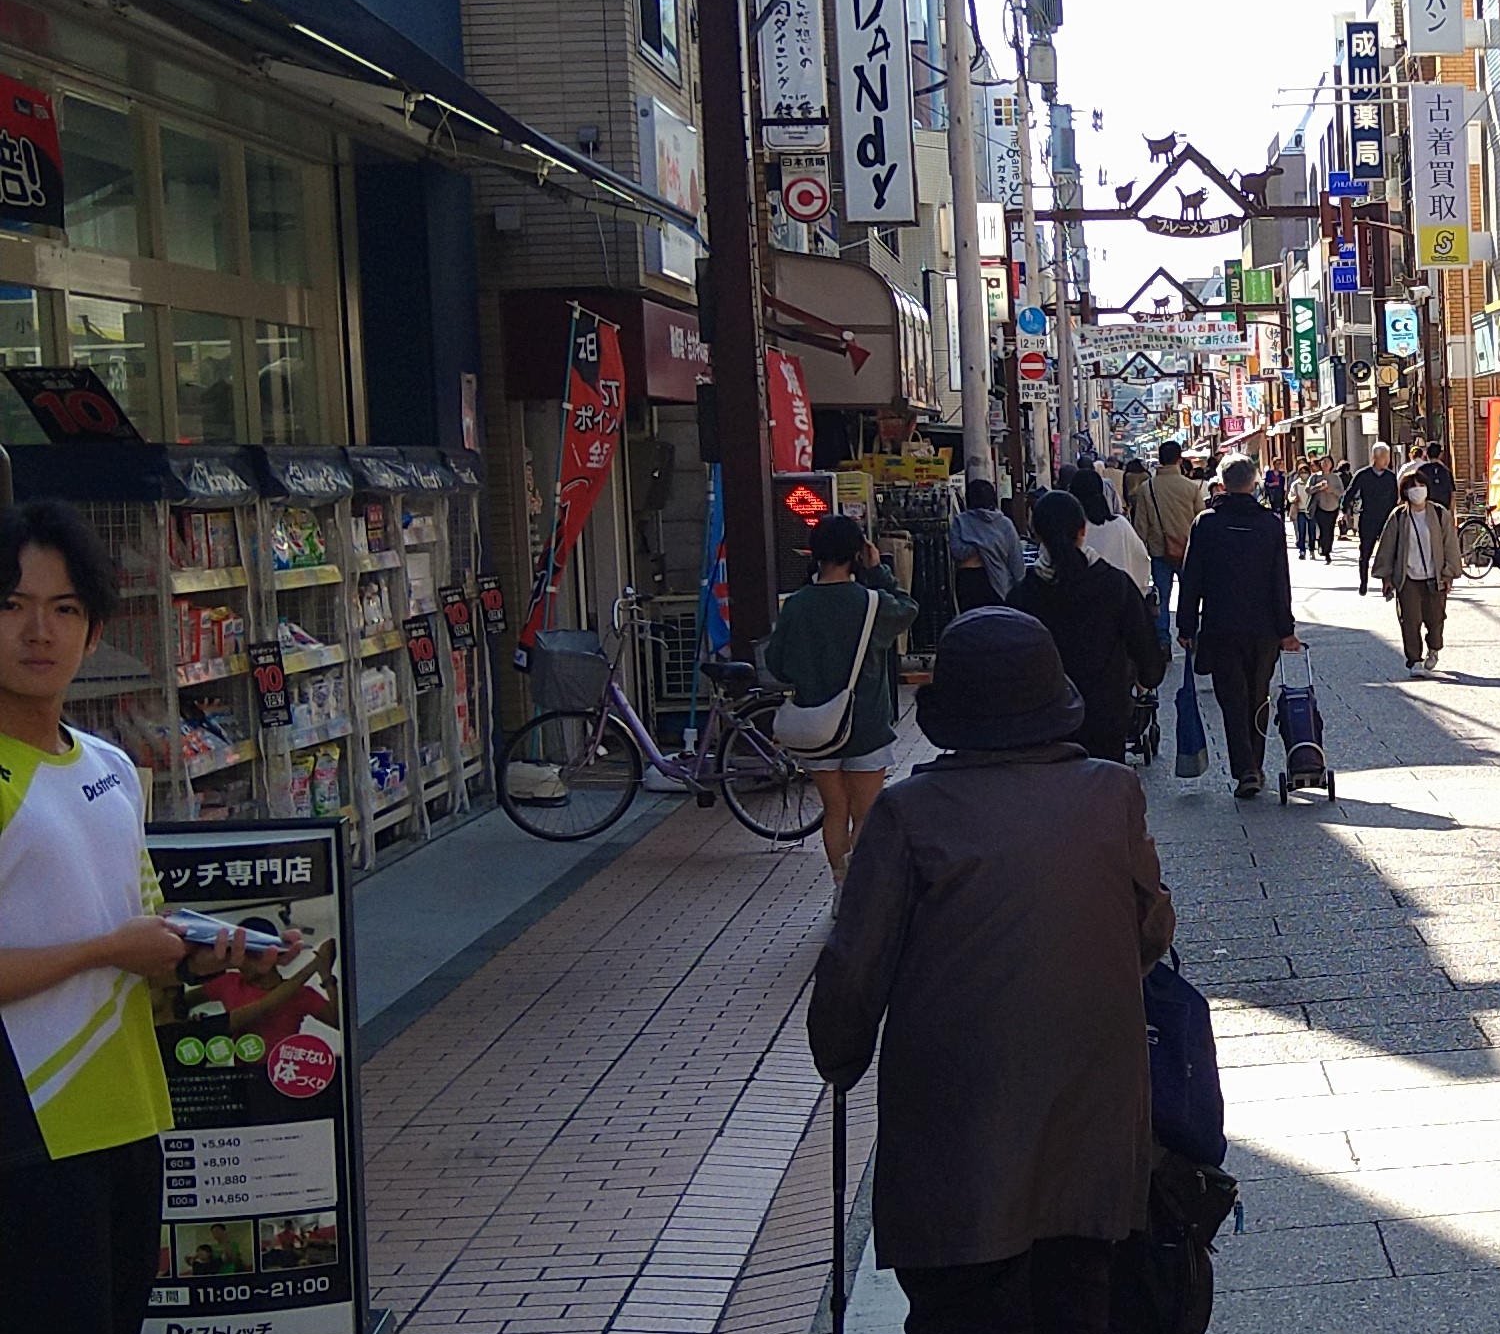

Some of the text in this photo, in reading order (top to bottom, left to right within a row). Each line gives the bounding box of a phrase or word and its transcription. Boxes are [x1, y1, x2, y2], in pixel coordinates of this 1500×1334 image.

[1350, 29, 1382, 168] 成川薬局
[1425, 93, 1457, 222] 古着買取
[1156, 218, 1229, 235] ブレーメン通り
[1019, 338, 1045, 349] 12-19
[1299, 339, 1313, 374] MOS
[480, 588, 504, 611] 10
[443, 602, 469, 627] 10
[407, 637, 430, 662] 10
[253, 664, 284, 695] 10
[156, 856, 312, 889] ッチ専門店
